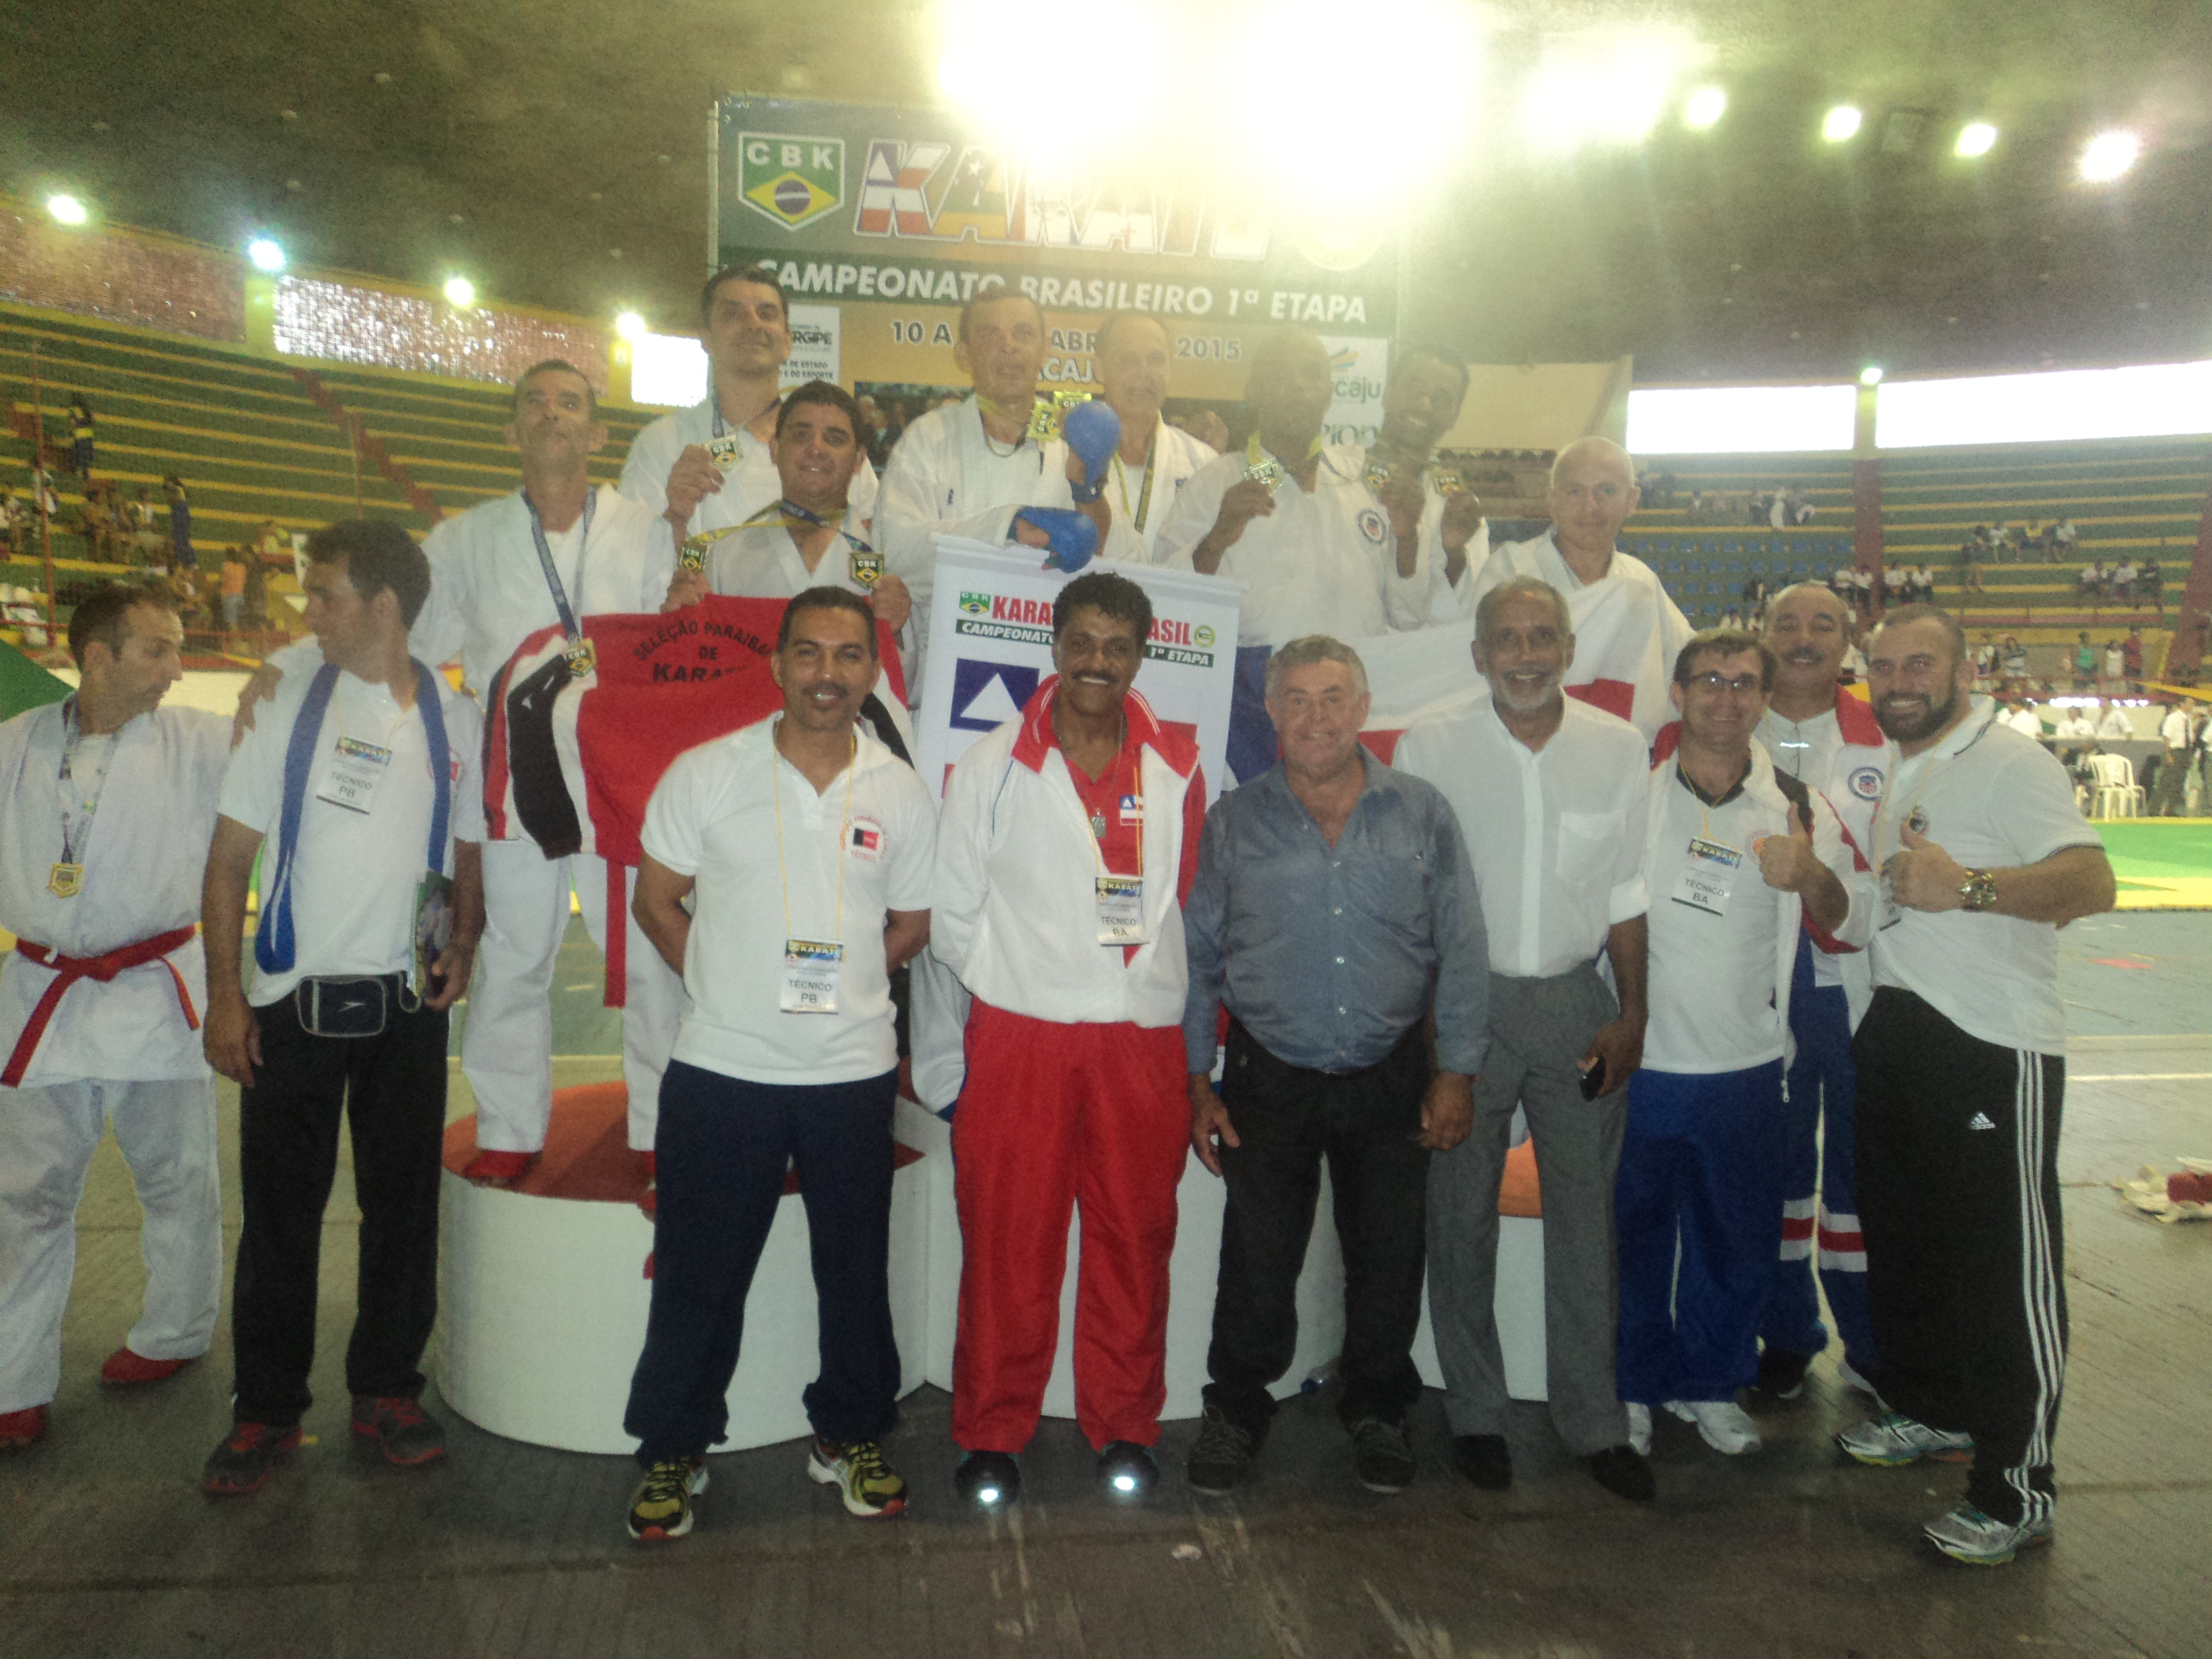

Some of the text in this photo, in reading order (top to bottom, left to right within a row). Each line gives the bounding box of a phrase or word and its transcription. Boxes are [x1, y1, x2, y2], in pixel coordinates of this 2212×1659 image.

[747, 141, 835, 171] CBK
[1021, 276, 1213, 316] BRASILEIRO
[1270, 292, 1367, 324] ETAPA
[793, 331, 833, 345] RGIPE
[892, 319, 1242, 362] 10 A ABR 2015
[1334, 377, 1382, 404] caju
[992, 595, 1053, 626] KARA
[1147, 617, 1192, 646] ASIL
[699, 645, 719, 661] DE
[1167, 649, 1210, 666] ETAPA
[800, 992, 818, 1004] PB
